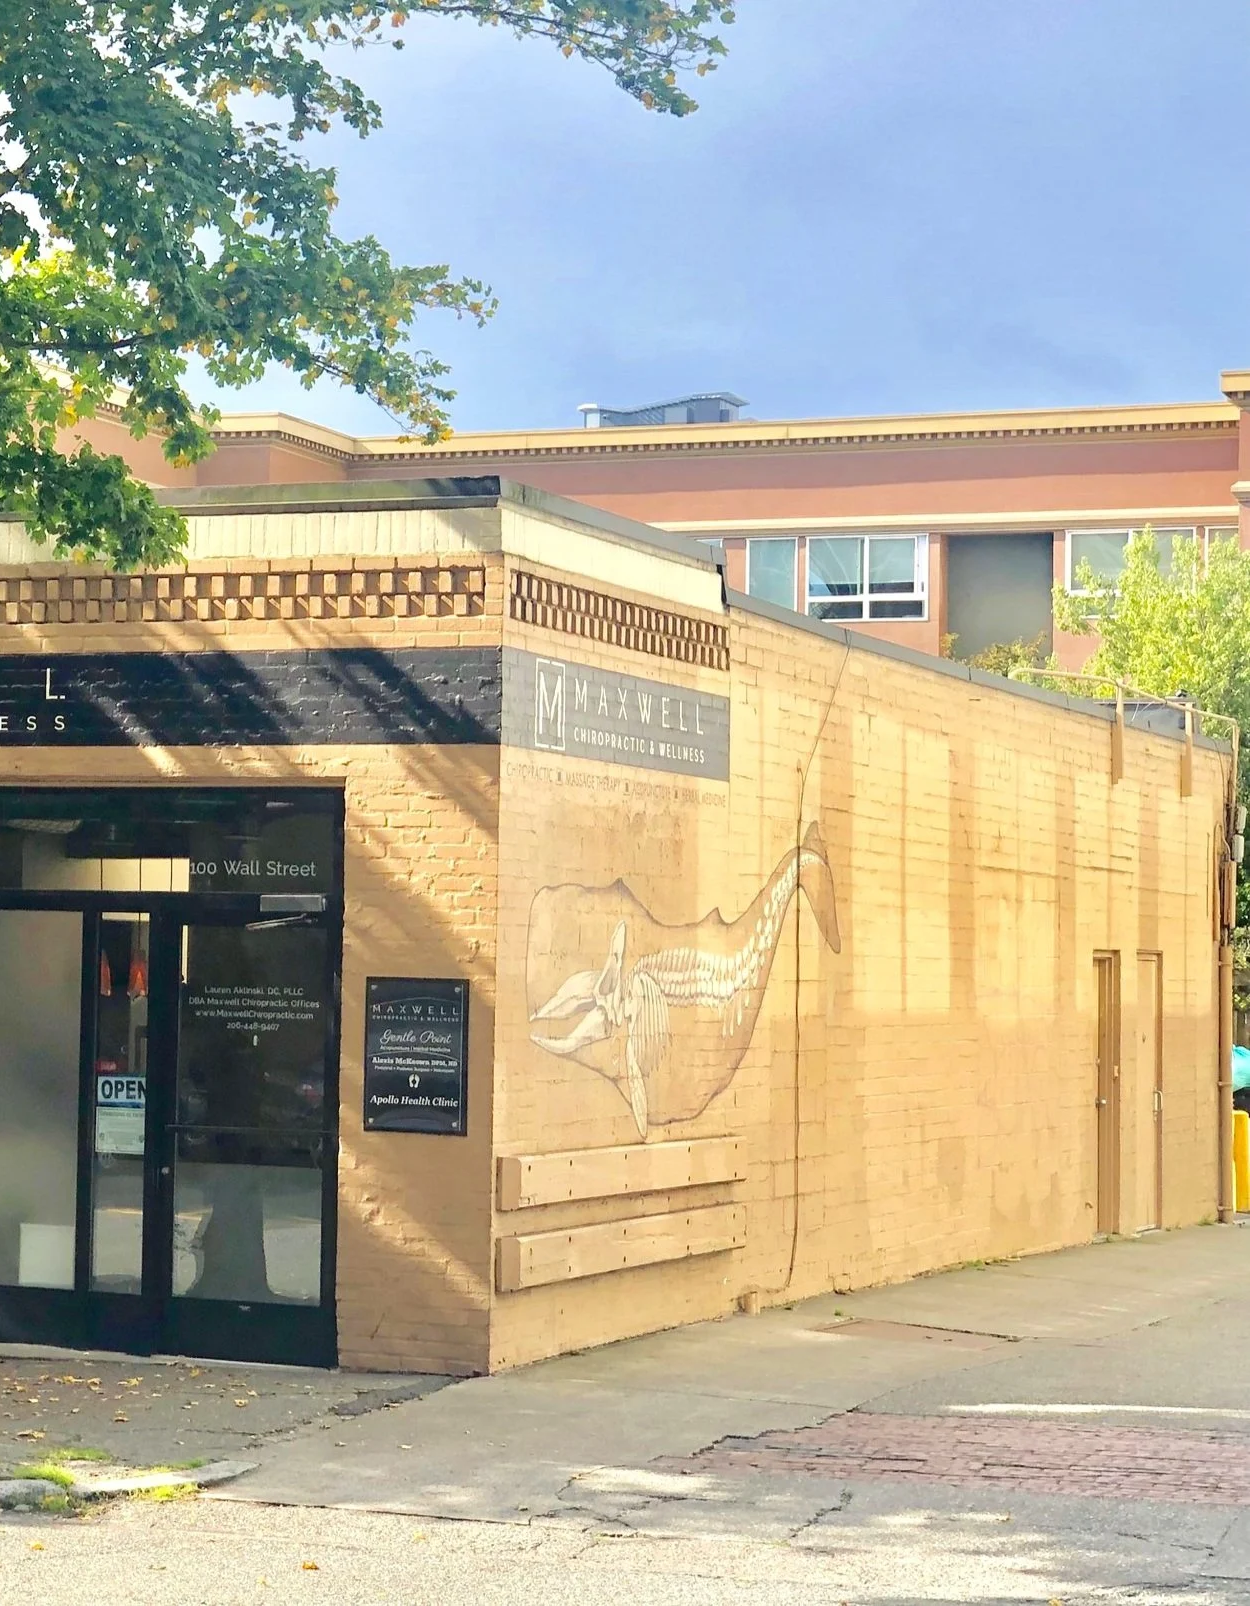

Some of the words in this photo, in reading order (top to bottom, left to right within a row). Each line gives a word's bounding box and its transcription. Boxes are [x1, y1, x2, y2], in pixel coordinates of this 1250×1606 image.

[538, 669, 563, 739] M
[574, 677, 704, 735] MAXWELL
[573, 726, 645, 754] CHIROPRACTIC
[649, 740, 655, 756] &
[658, 741, 706, 764] WELLNESS
[189, 861, 217, 875] 100
[224, 860, 261, 876] Wall
[266, 860, 317, 877] Street
[204, 985, 232, 994] Lauren
[283, 987, 305, 996] PLLC
[188, 996, 205, 1005] DBA
[206, 997, 240, 1006] Maxwell
[241, 998, 289, 1008] Chiropractic
[290, 1000, 320, 1009] Offices
[372, 1005, 459, 1015] MAXWELL
[380, 1029, 416, 1044] Gentle
[420, 1030, 452, 1044] Point
[101, 1079, 146, 1100] OPEN
[369, 1094, 400, 1106] Apollo
[400, 1095, 431, 1107] Health
[432, 1096, 459, 1108] Clinic
